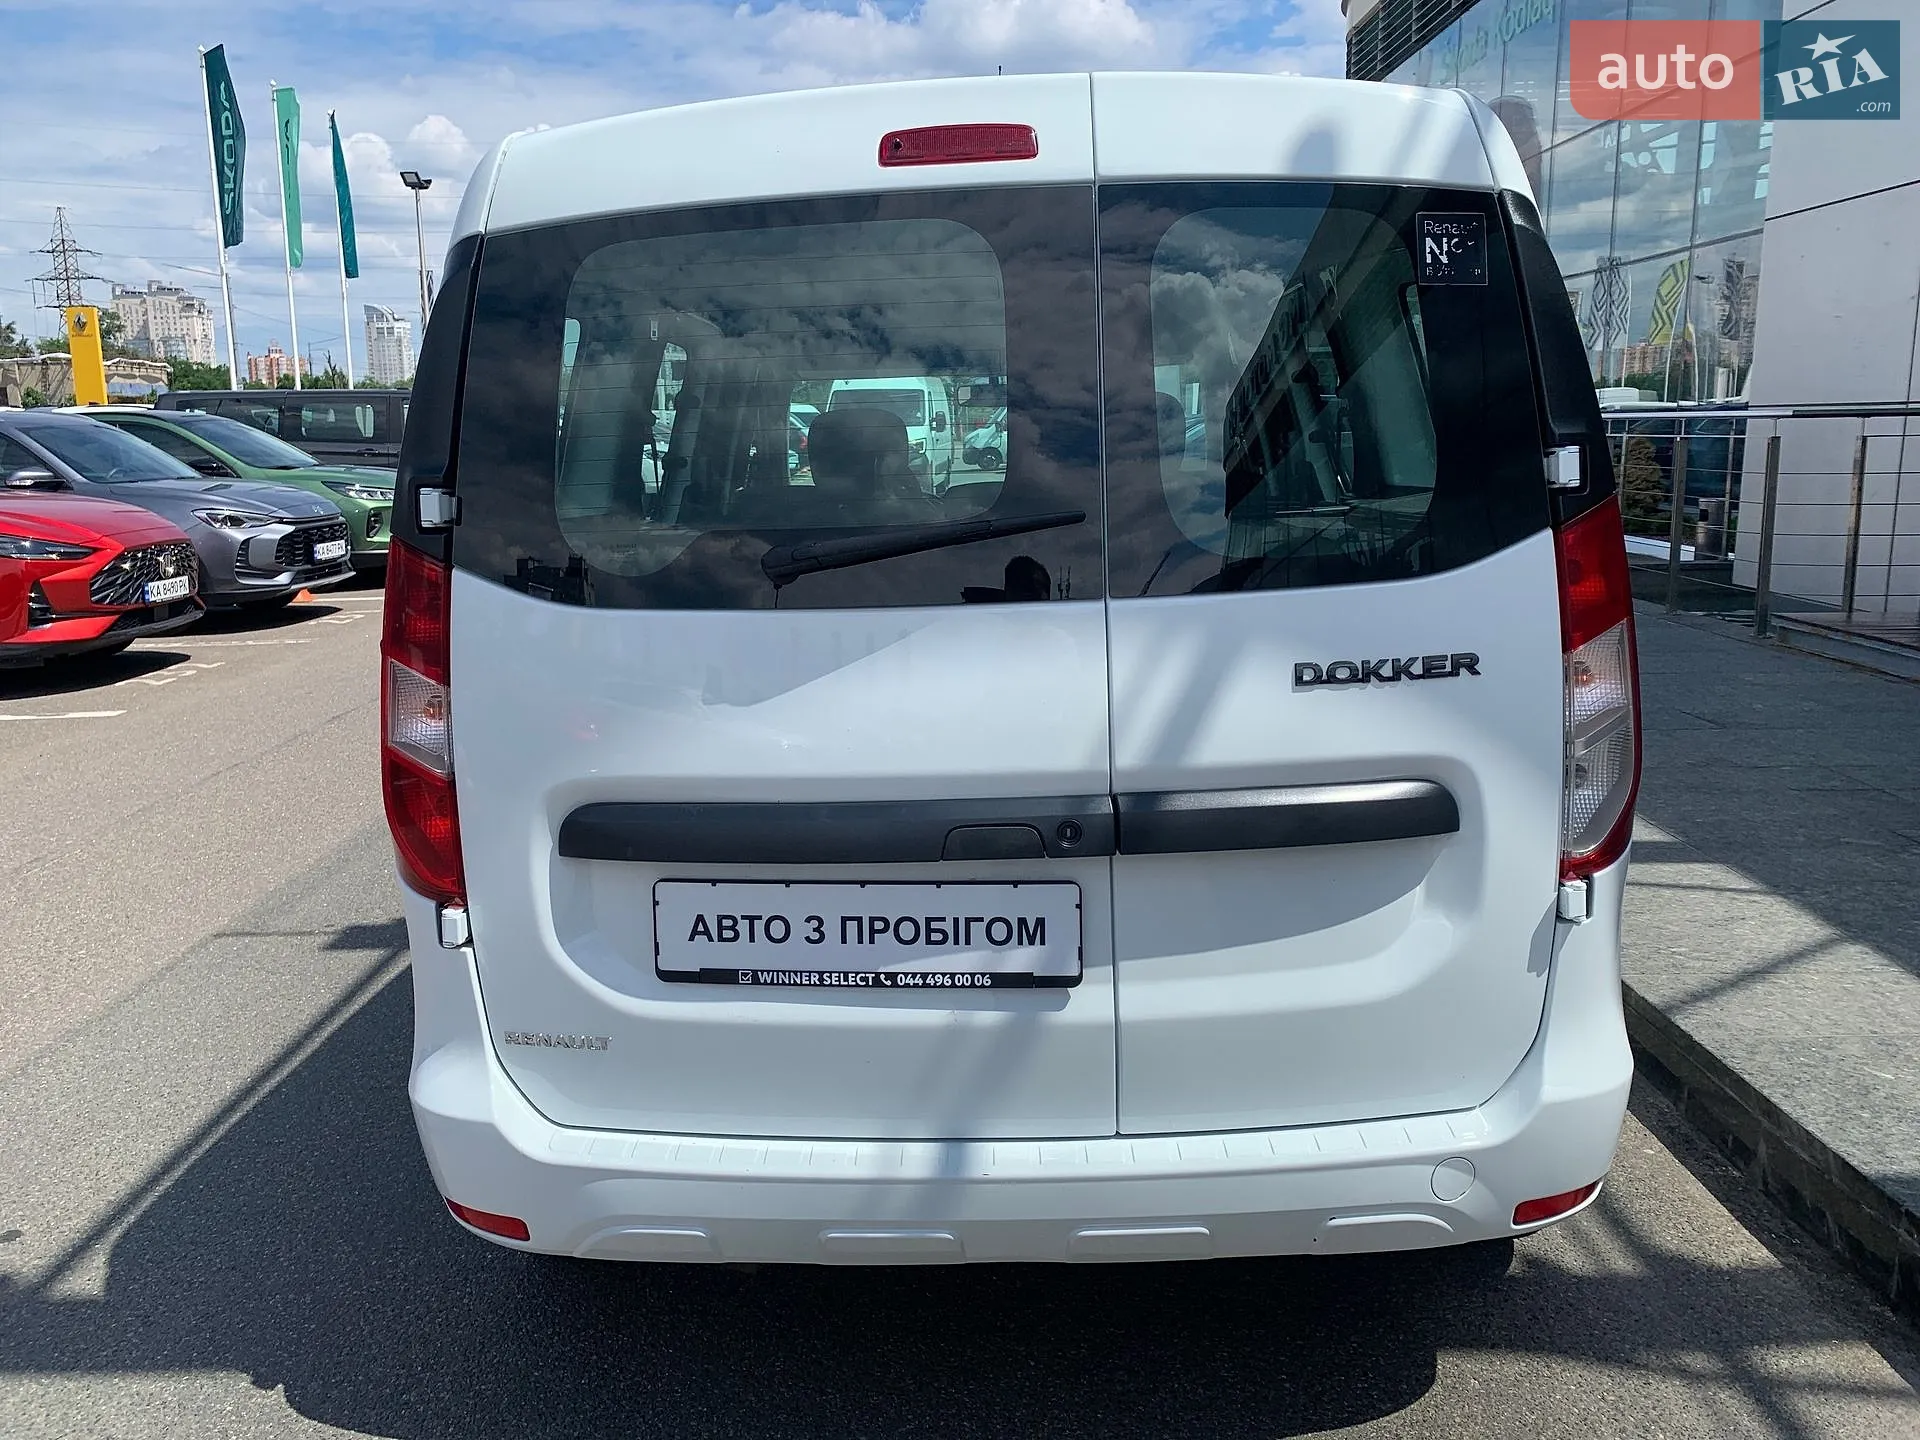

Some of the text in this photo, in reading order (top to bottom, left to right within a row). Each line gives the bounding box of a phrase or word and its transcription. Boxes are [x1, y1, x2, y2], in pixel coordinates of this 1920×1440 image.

[1294, 652, 1481, 687] DOKKER
[688, 914, 791, 943] АВТО
[839, 915, 1046, 946] ПРОБІГОМ
[757, 971, 876, 986] WINNER SELECT
[896, 973, 992, 987] 044 496 00 06
[503, 1030, 612, 1051] RENAULT
